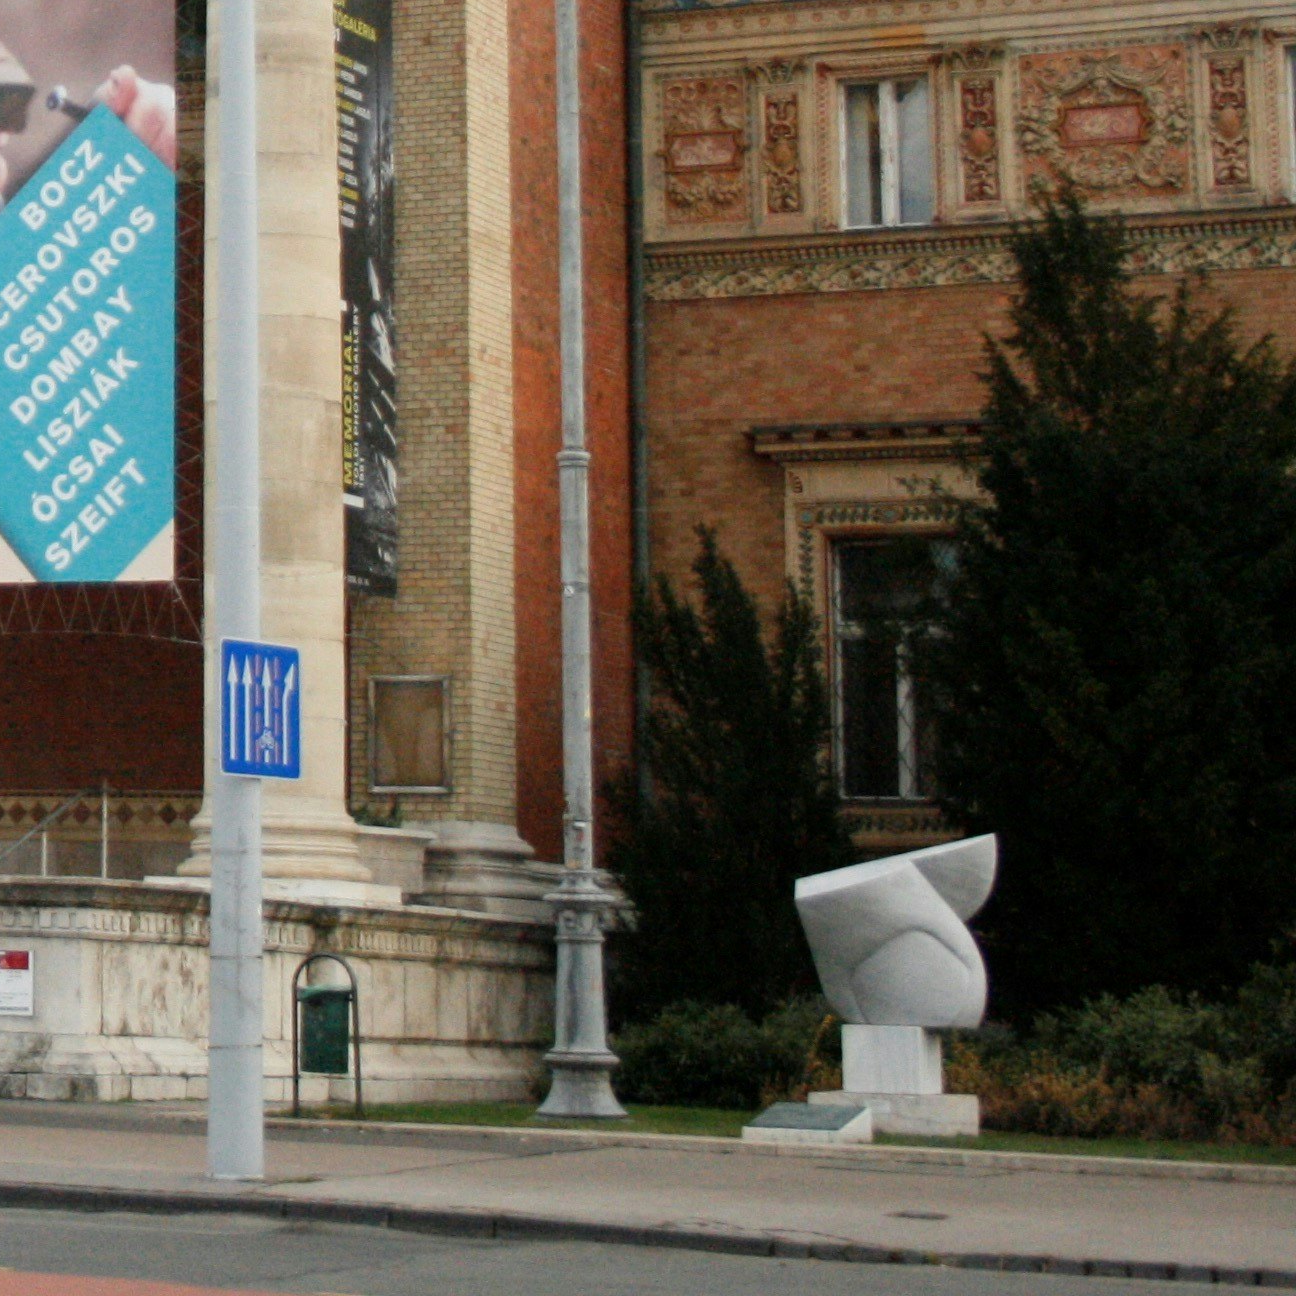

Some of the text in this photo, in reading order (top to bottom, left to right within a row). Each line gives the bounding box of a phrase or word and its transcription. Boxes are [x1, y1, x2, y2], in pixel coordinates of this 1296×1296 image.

[19, 139, 104, 230] BOCZ
[4, 205, 156, 370] CSUTOROS
[9, 285, 133, 424] DOMBAY
[23, 346, 139, 472] LISZIÁK
[343, 330, 353, 486] MEMORIAL
[31, 423, 125, 523] ÓCSAI
[45, 457, 146, 571] SZEIFT
